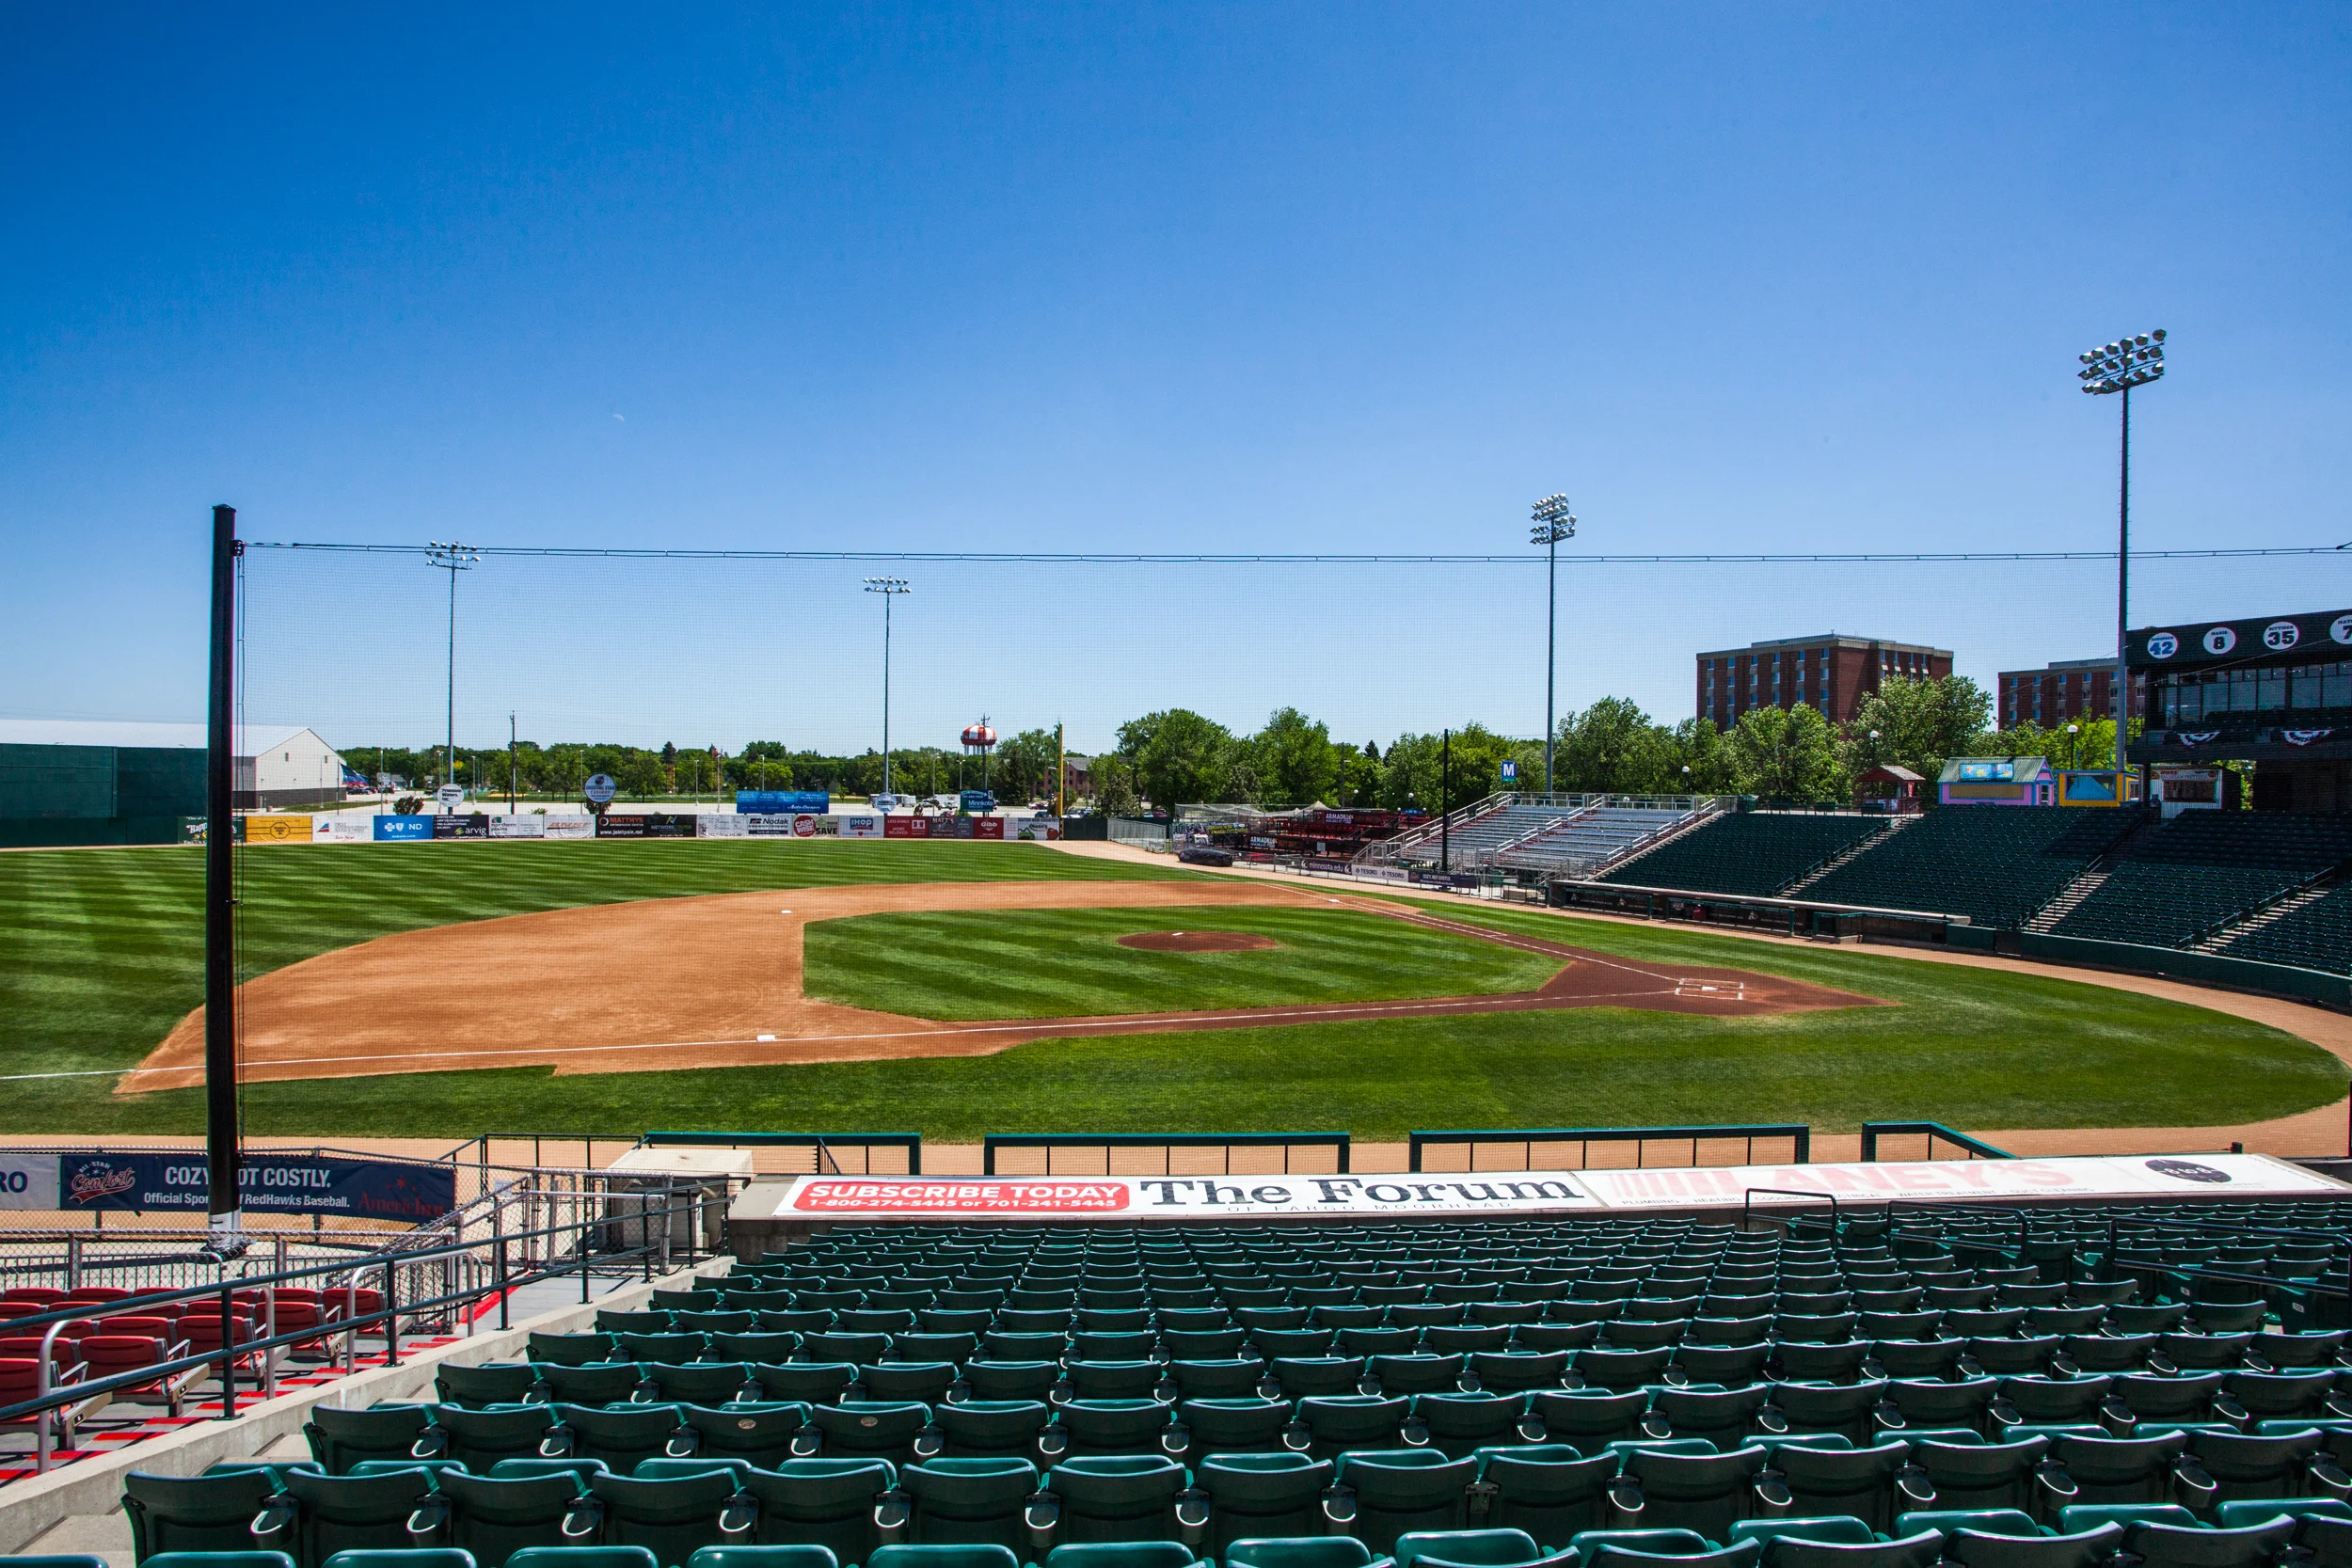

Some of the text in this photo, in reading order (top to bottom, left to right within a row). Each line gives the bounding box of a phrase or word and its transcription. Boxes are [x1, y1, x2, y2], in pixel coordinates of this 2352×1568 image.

[2213, 636, 2225, 650] 8
[2267, 630, 2295, 646] 35
[2149, 641, 2174, 656] 42
[1502, 763, 1515, 776] M
[795, 819, 814, 828] CASH
[465, 826, 486, 835] arvig
[816, 827, 838, 835] SAVE
[1310, 862, 1343, 873] minnesota.edu
[1360, 867, 1377, 876] TESORO
[72, 1166, 136, 1192] Comfort
[238, 1167, 260, 1186] OT
[262, 1167, 332, 1188] COSTLY.
[808, 1185, 1122, 1198] SUBSCRIBE TODAY
[1139, 1179, 1585, 1206] The Forum
[144, 1192, 183, 1204] Official
[245, 1194, 302, 1206] RedHawks
[303, 1195, 350, 1208] Baseball.
